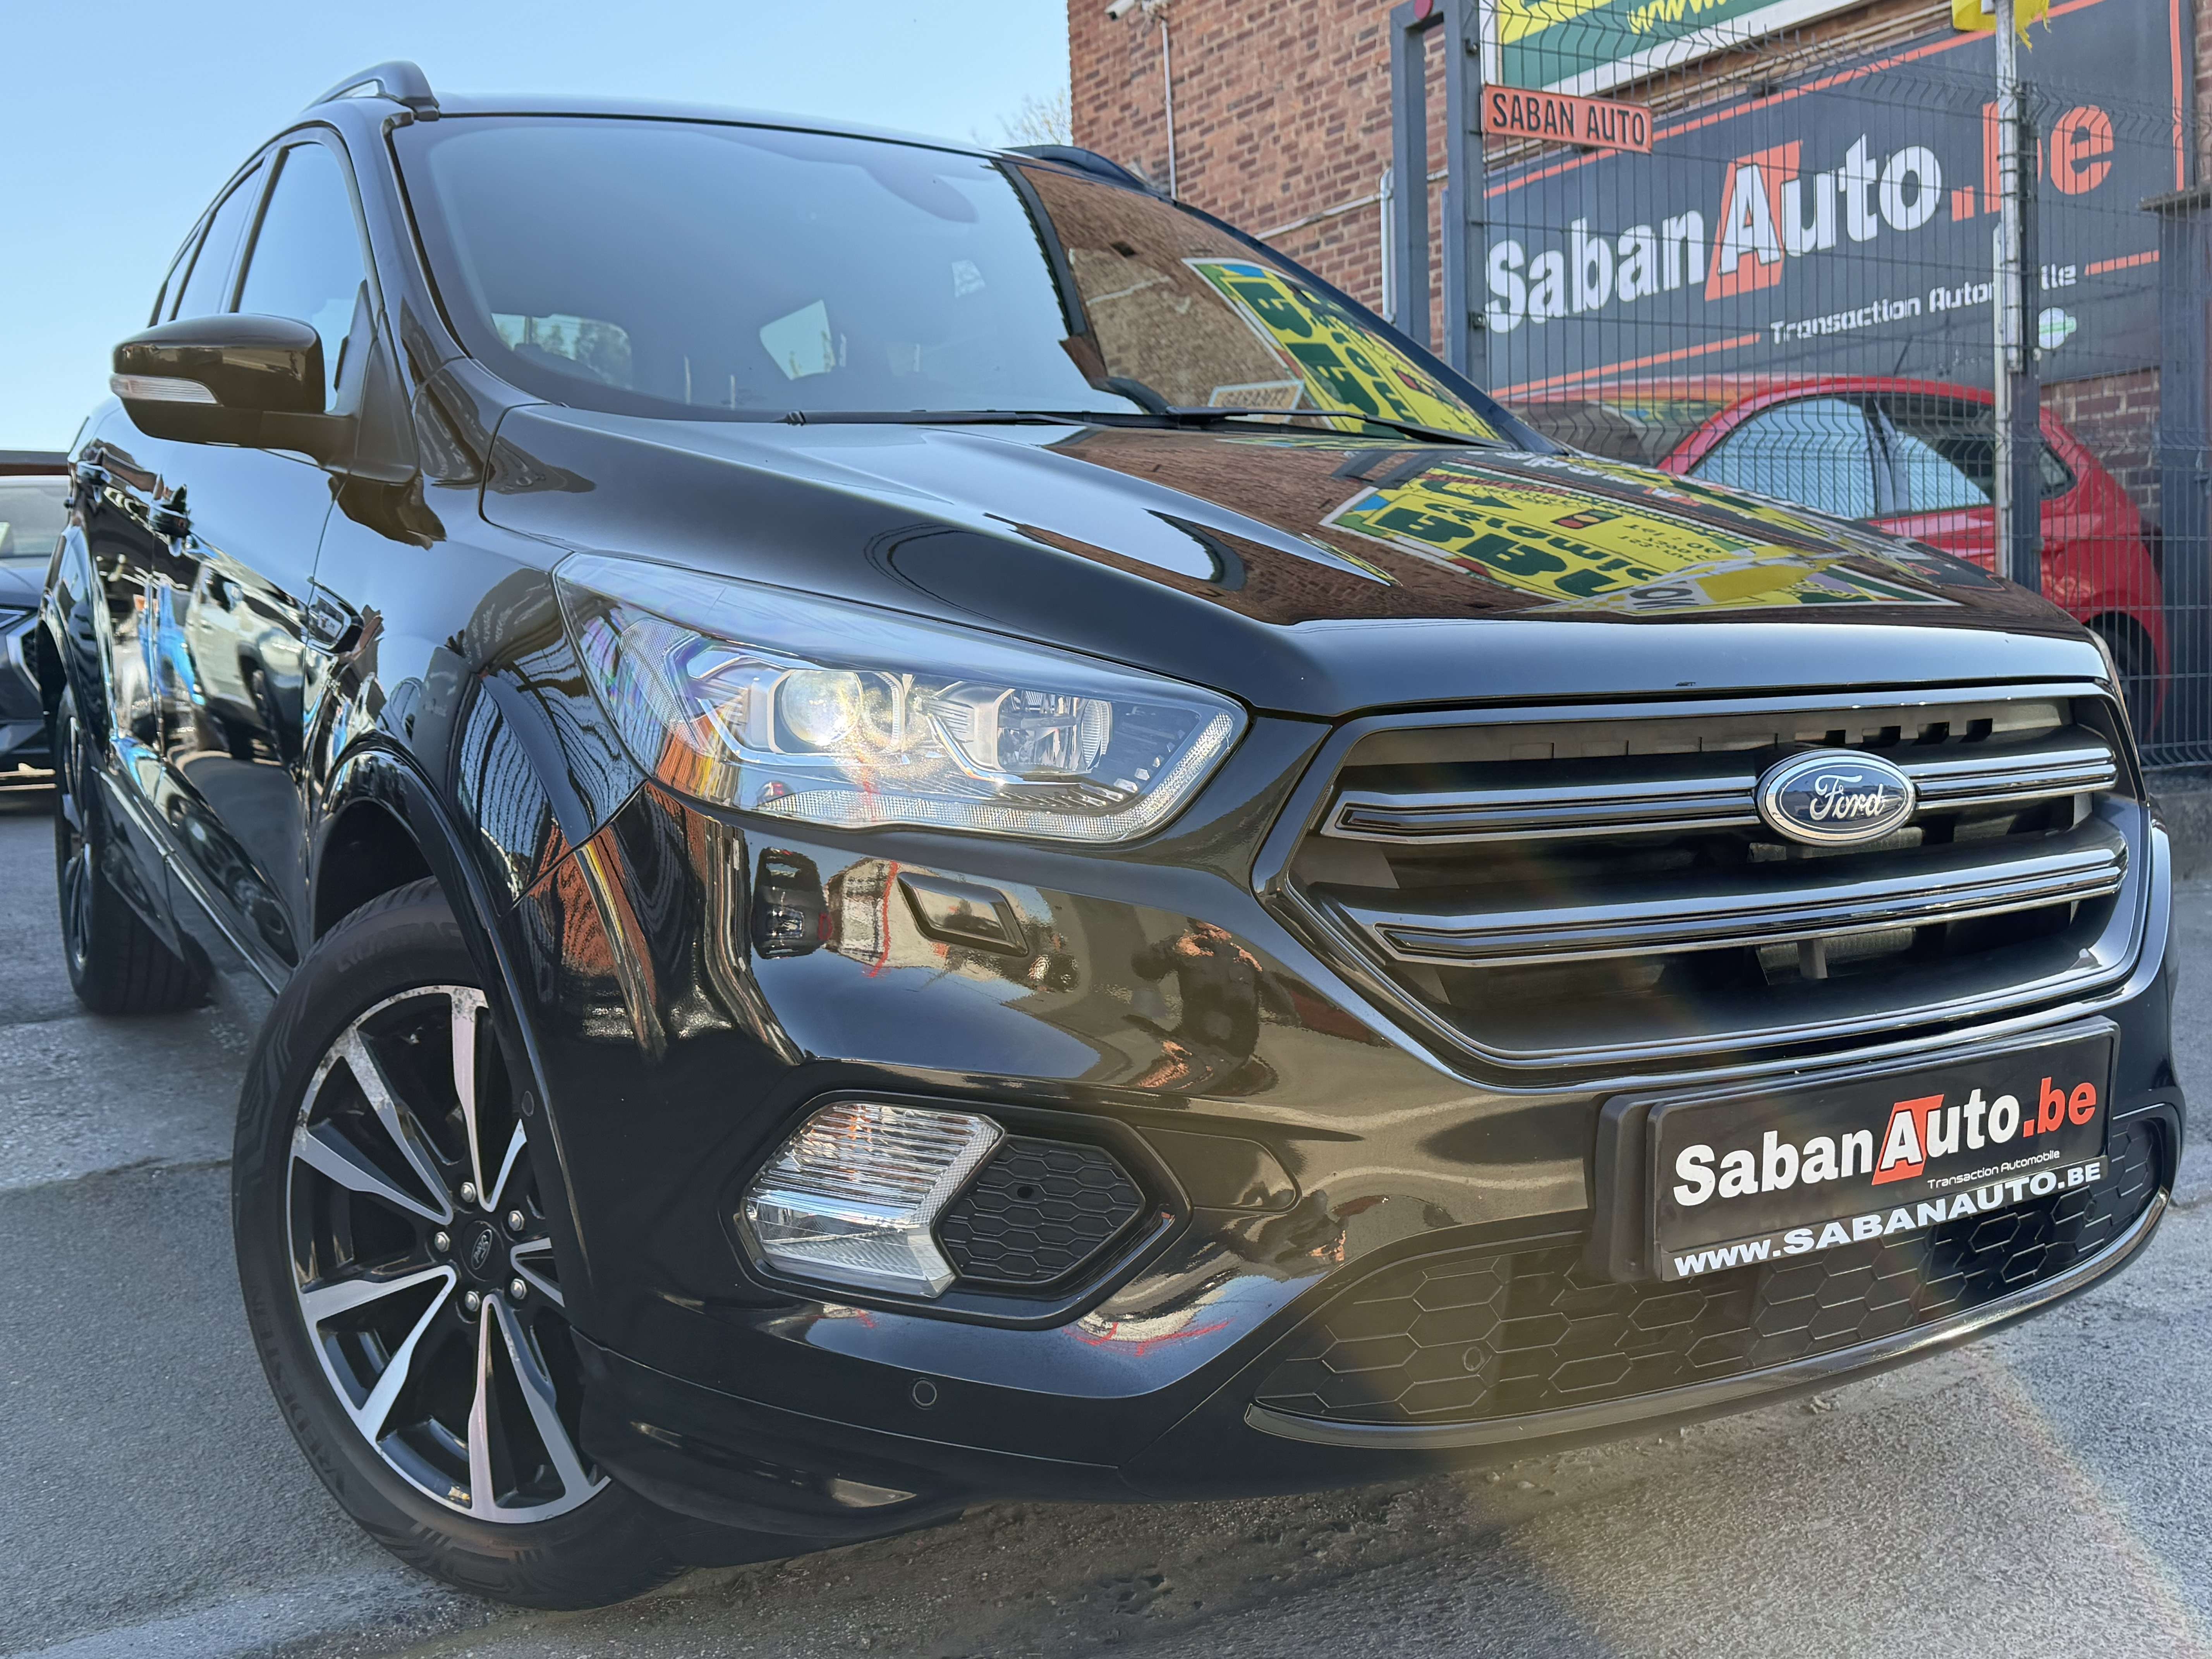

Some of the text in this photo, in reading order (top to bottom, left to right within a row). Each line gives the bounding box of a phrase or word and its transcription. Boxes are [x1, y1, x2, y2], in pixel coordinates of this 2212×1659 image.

[1492, 93, 1645, 146] SABAN AUTO
[1770, 263, 2076, 344] Transaction Autoile
[1809, 775, 1884, 821] Ford
[1673, 1076, 2098, 1207] SabanAuto.be
[1927, 1150, 2060, 1189] Transaction Automobile
